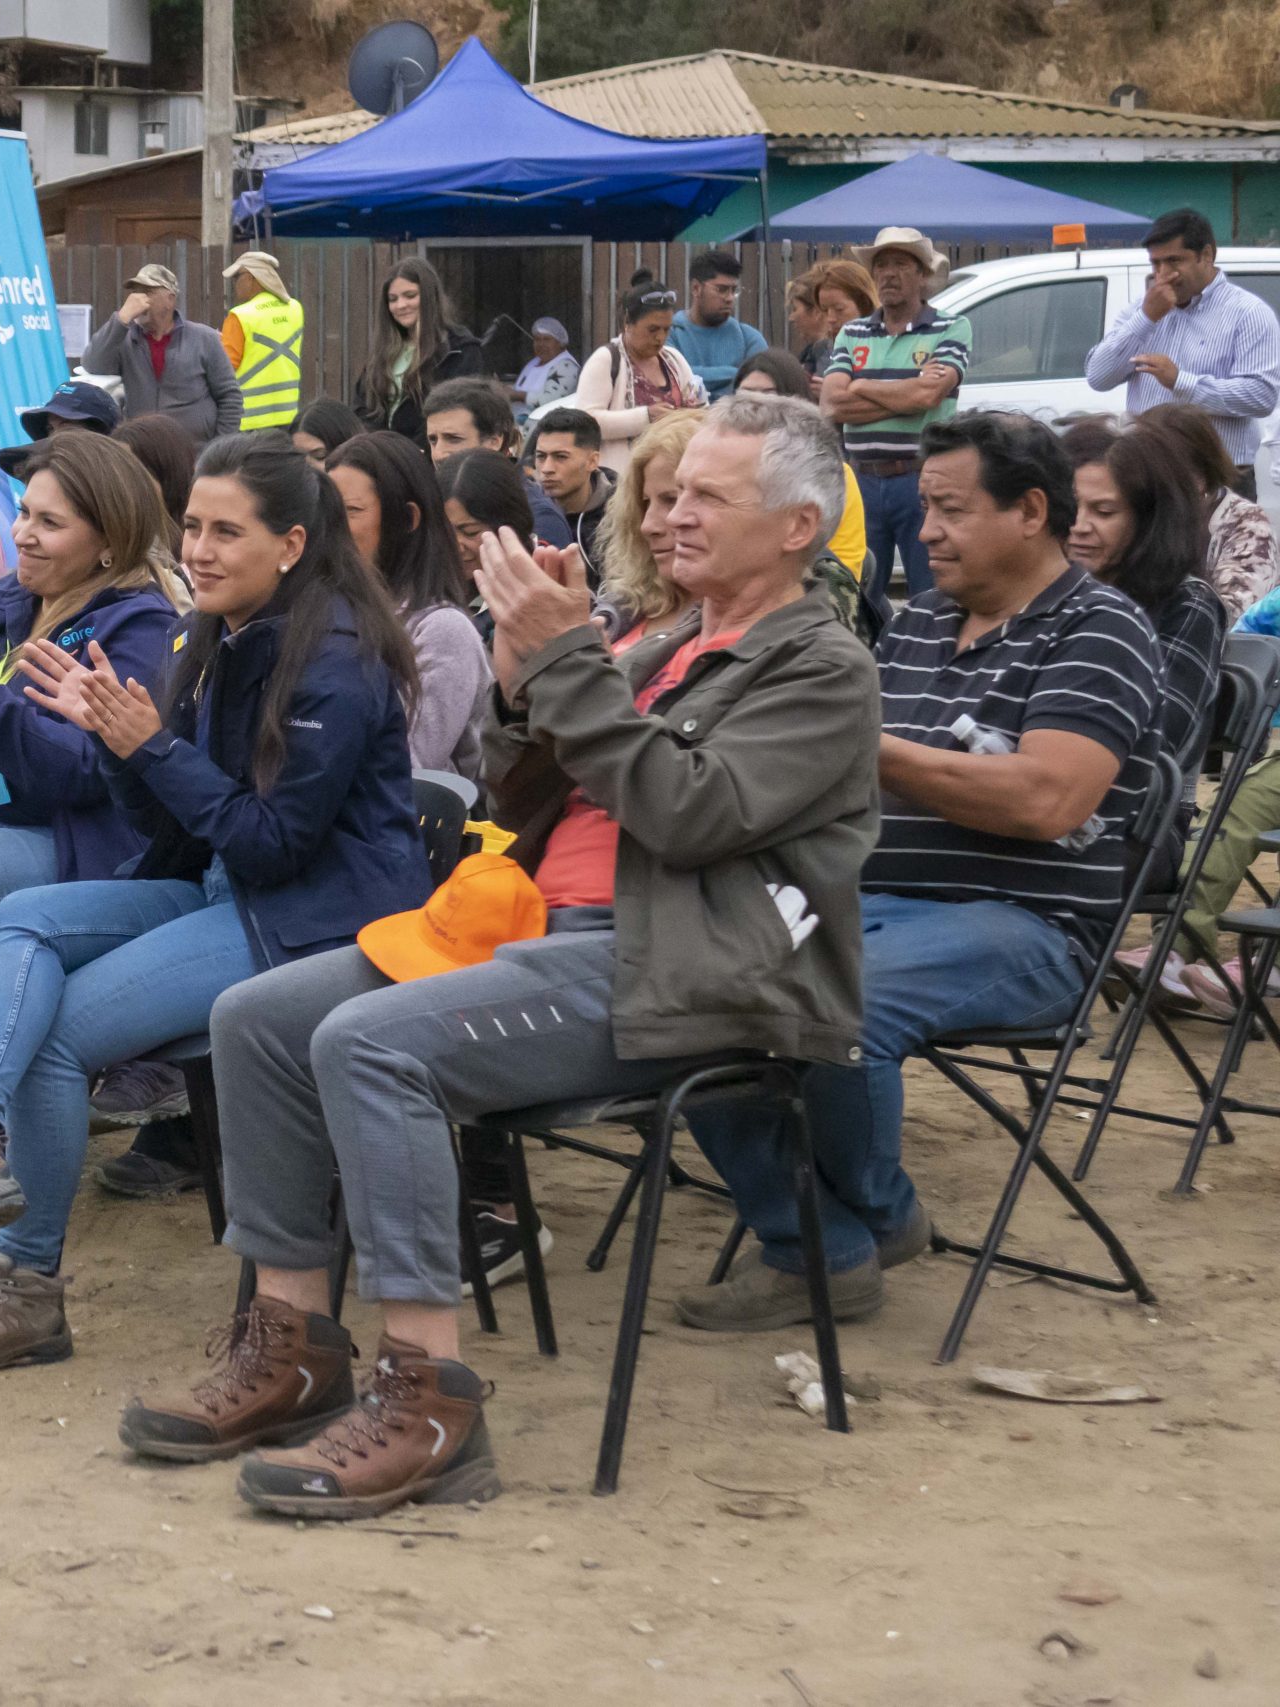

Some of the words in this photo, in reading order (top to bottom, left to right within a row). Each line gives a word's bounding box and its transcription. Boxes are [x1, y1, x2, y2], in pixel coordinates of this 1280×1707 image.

[22, 310, 51, 331] social
[852, 345, 870, 373] 3
[61, 626, 95, 646] enre
